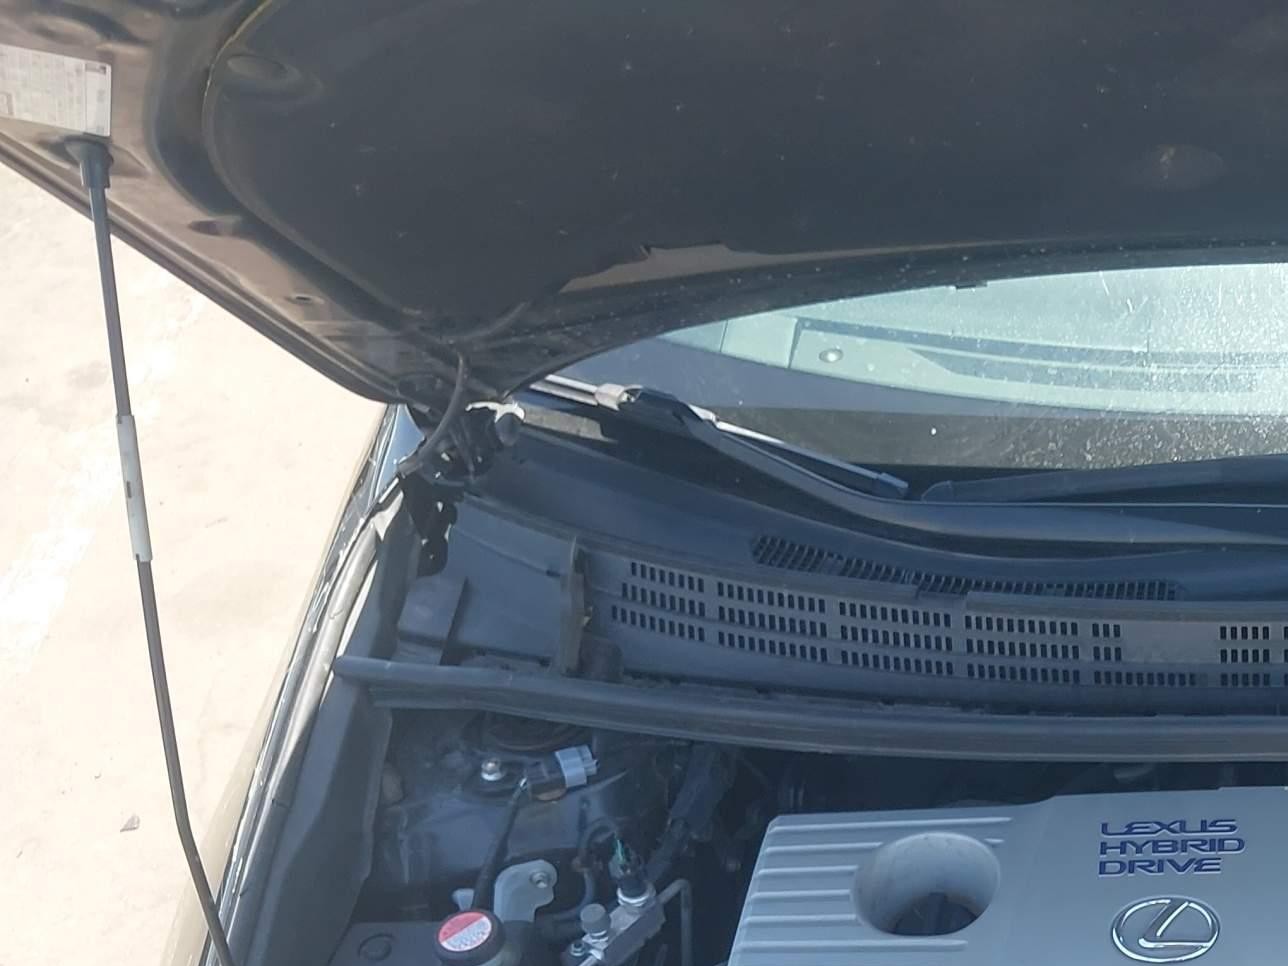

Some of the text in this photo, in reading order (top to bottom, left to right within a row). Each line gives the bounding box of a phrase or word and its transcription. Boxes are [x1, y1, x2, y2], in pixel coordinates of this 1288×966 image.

[1100, 819, 1238, 836] LEXUS
[1100, 838, 1245, 856] HYBRID
[1098, 857, 1222, 877] DRIVE
